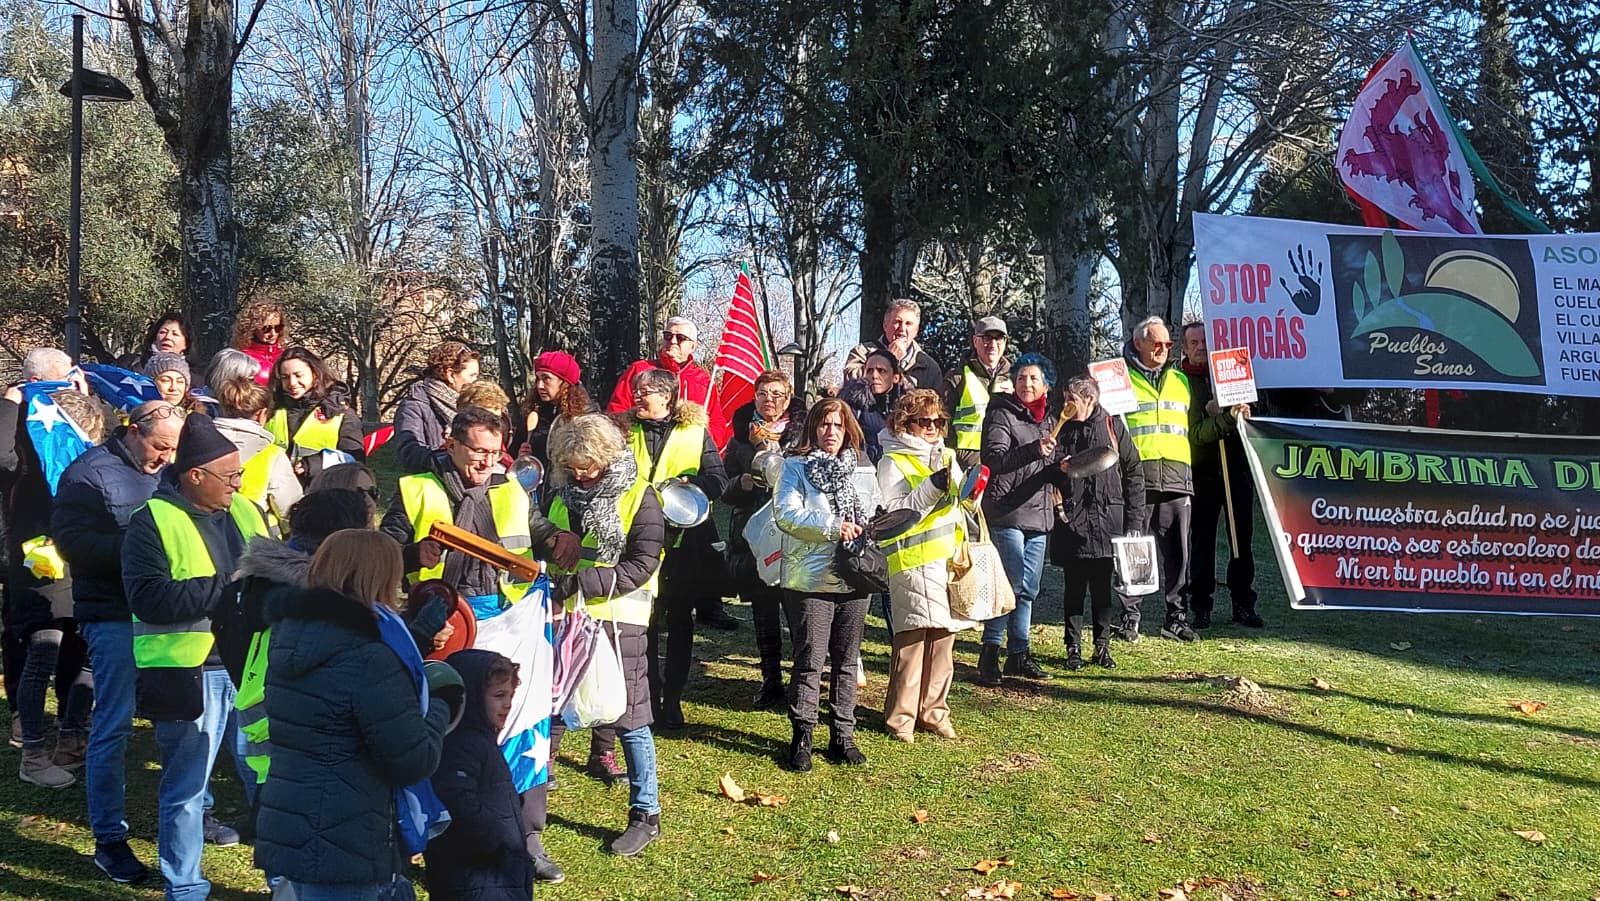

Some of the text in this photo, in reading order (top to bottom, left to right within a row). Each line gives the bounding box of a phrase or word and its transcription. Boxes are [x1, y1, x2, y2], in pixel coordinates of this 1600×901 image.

[1208, 263, 1272, 305] STOP
[1553, 277, 1573, 290] EL
[1212, 308, 1308, 360] BIOGÁS
[1556, 313, 1576, 327] EL
[1368, 332, 1448, 354] Pueblos
[1413, 354, 1476, 376] Sanos
[1275, 445, 1539, 489] JAMBRINA
[1311, 497, 1353, 521] Con
[1355, 501, 1441, 525] nuestra
[1441, 504, 1508, 527] salud
[1510, 513, 1537, 528] no
[1540, 512, 1570, 531] se
[1297, 531, 1402, 556] queremos
[1405, 537, 1441, 555] ser
[1446, 533, 1570, 558] estercolero
[1335, 556, 1362, 580] Ni
[1364, 565, 1391, 581] en
[1393, 559, 1417, 582] tu
[1419, 561, 1490, 590] pueblo
[1496, 564, 1518, 587] ni
[1519, 571, 1547, 588] en
[1550, 566, 1573, 589] el
